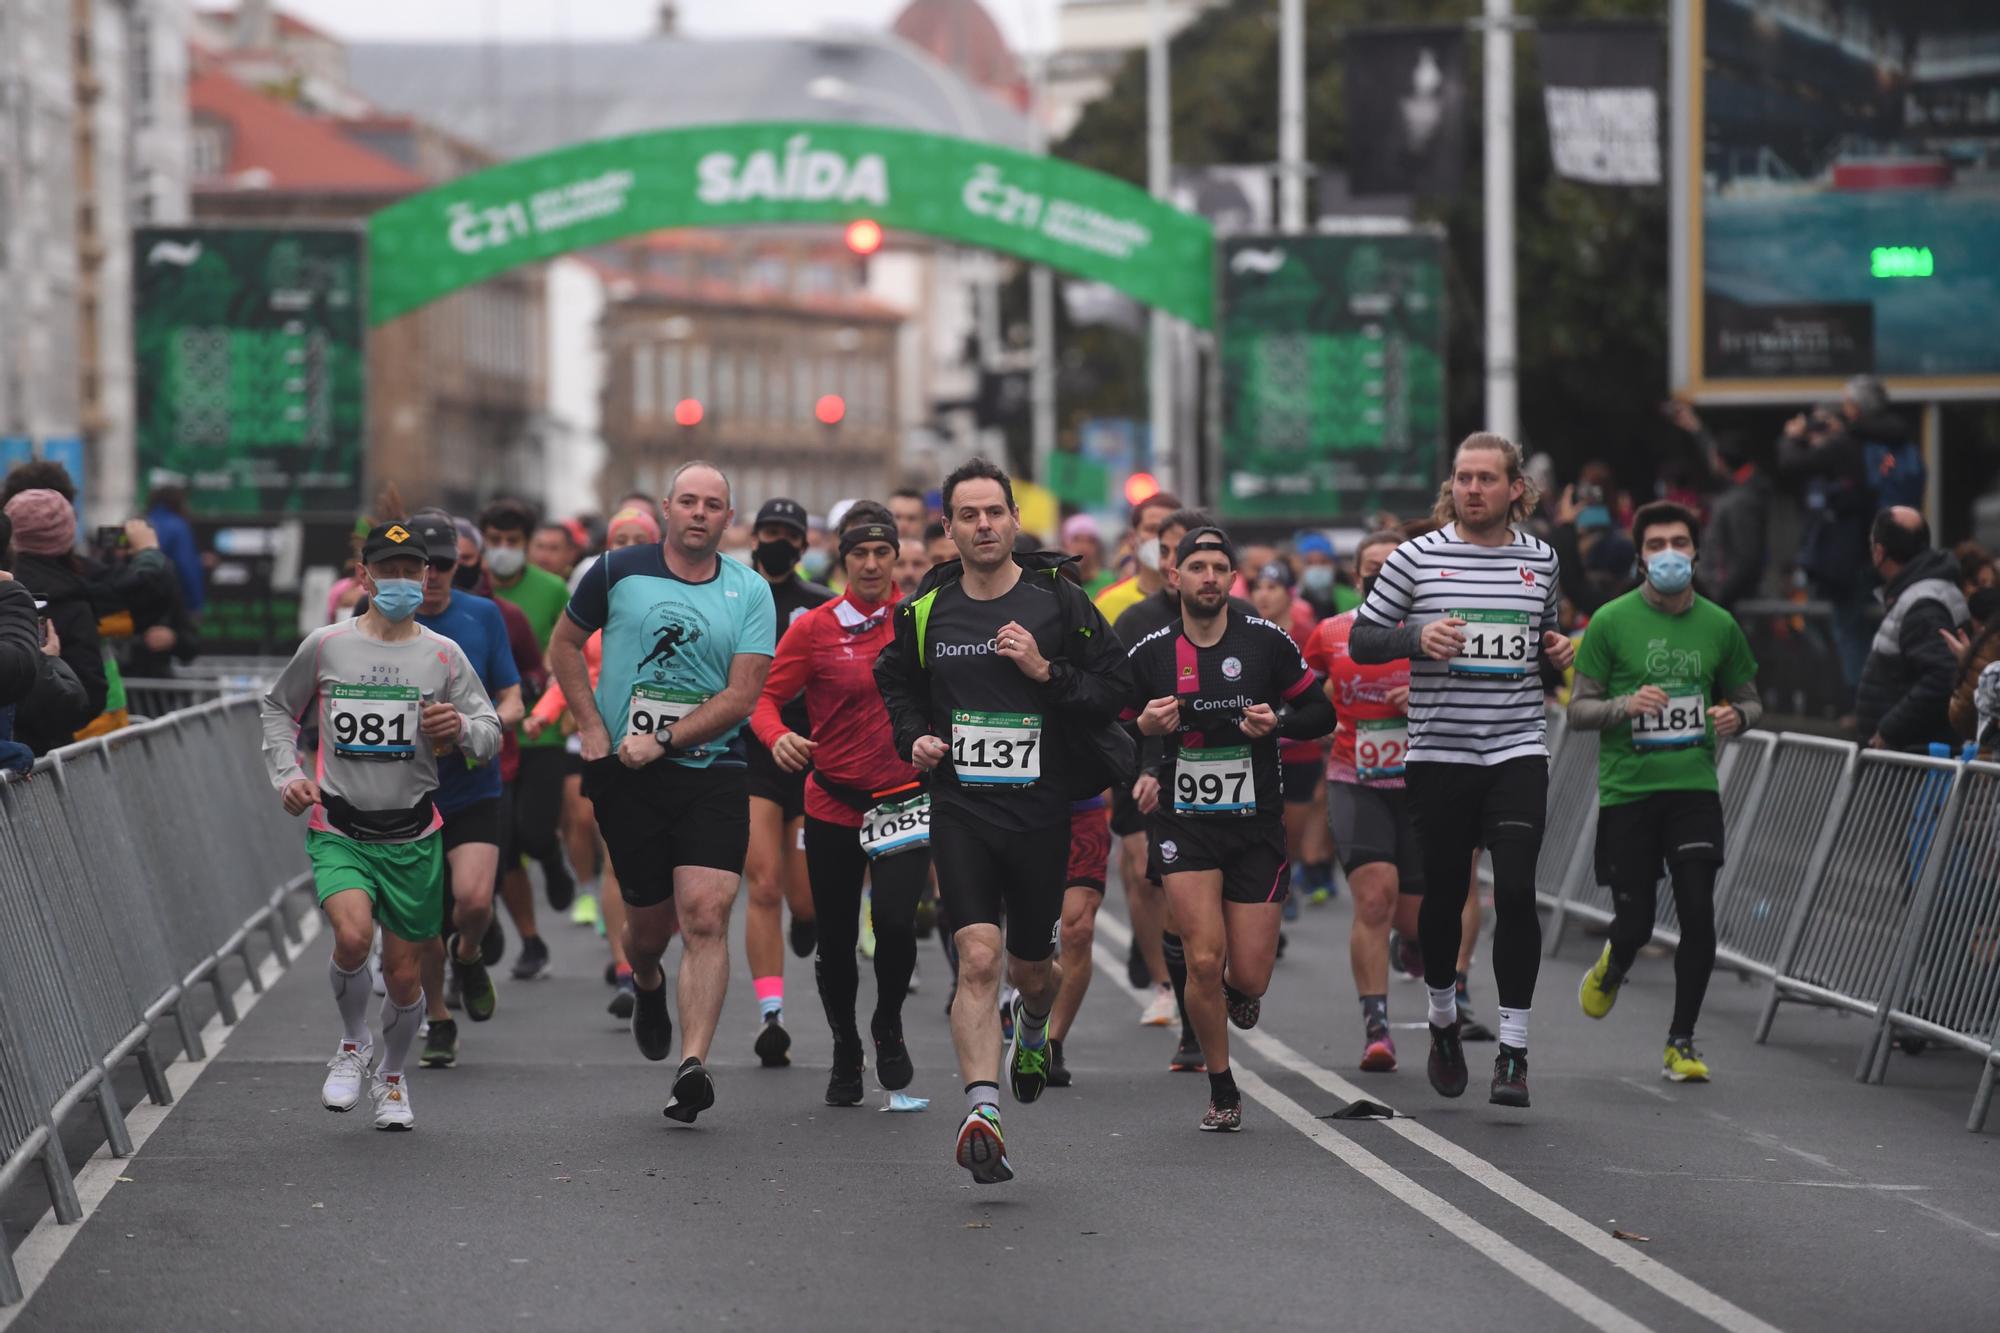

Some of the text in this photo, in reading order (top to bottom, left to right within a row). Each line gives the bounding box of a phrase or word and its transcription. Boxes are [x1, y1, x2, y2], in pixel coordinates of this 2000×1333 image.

[697, 133, 888, 206] SAÍDA
[1193, 695, 1253, 711] Concello
[334, 711, 412, 746] 981
[953, 736, 1037, 769] 1137
[1360, 740, 1408, 768] 92
[1177, 772, 1247, 805] 997
[861, 807, 931, 846] 1088
